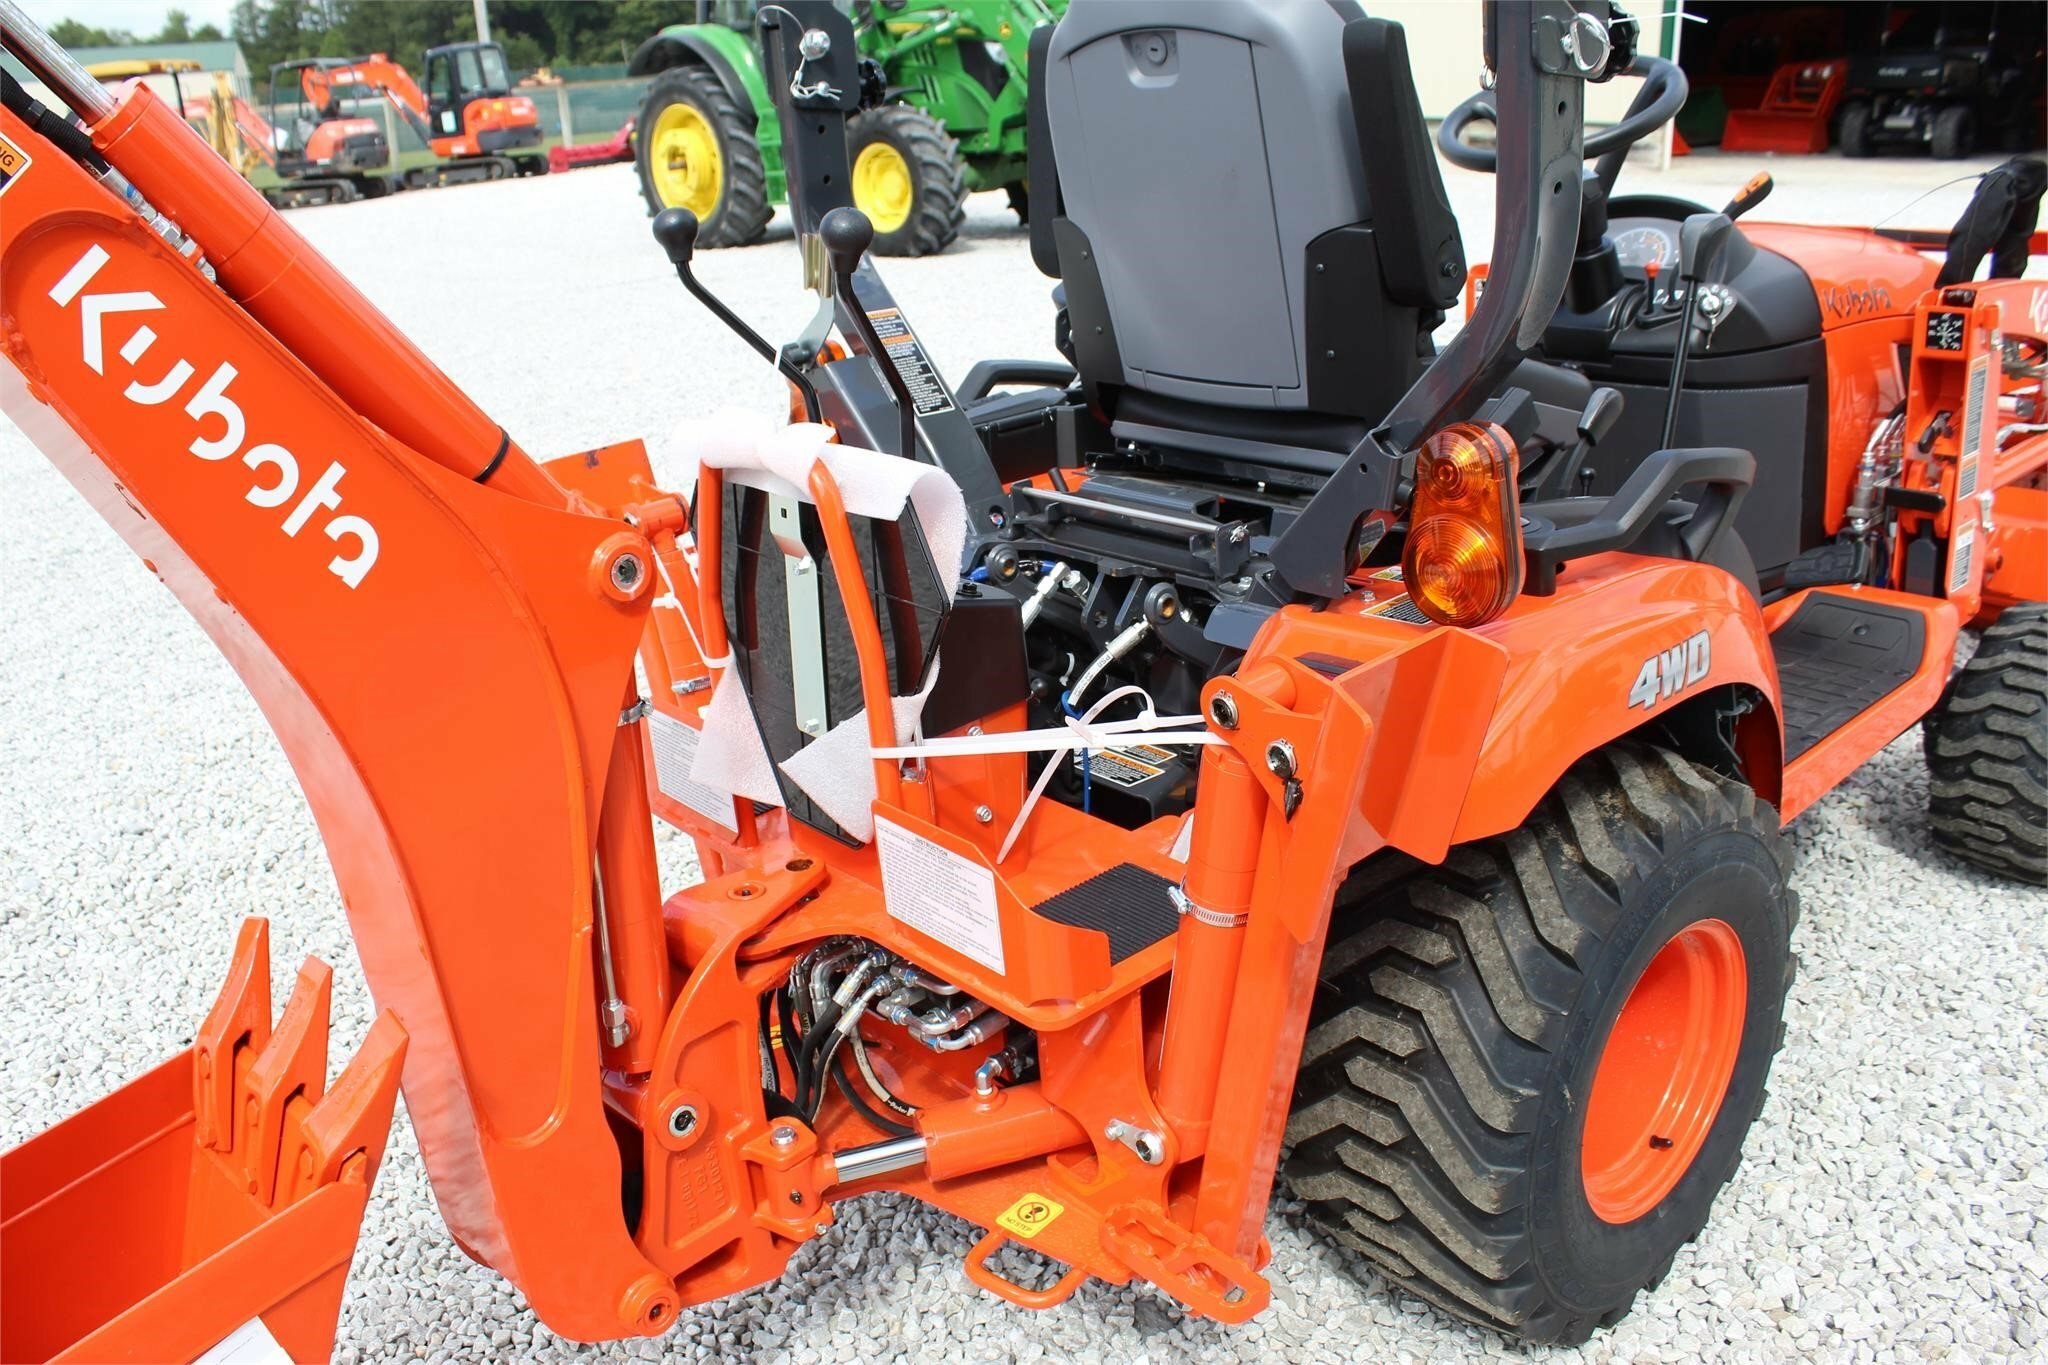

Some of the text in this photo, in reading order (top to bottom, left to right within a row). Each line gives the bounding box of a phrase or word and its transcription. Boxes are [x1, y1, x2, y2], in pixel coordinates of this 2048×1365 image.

[1823, 285, 1892, 319] Kubota
[48, 243, 379, 590] Kubota
[1628, 629, 1710, 711] 4WD
[1006, 1217, 1033, 1232] NO STEP
